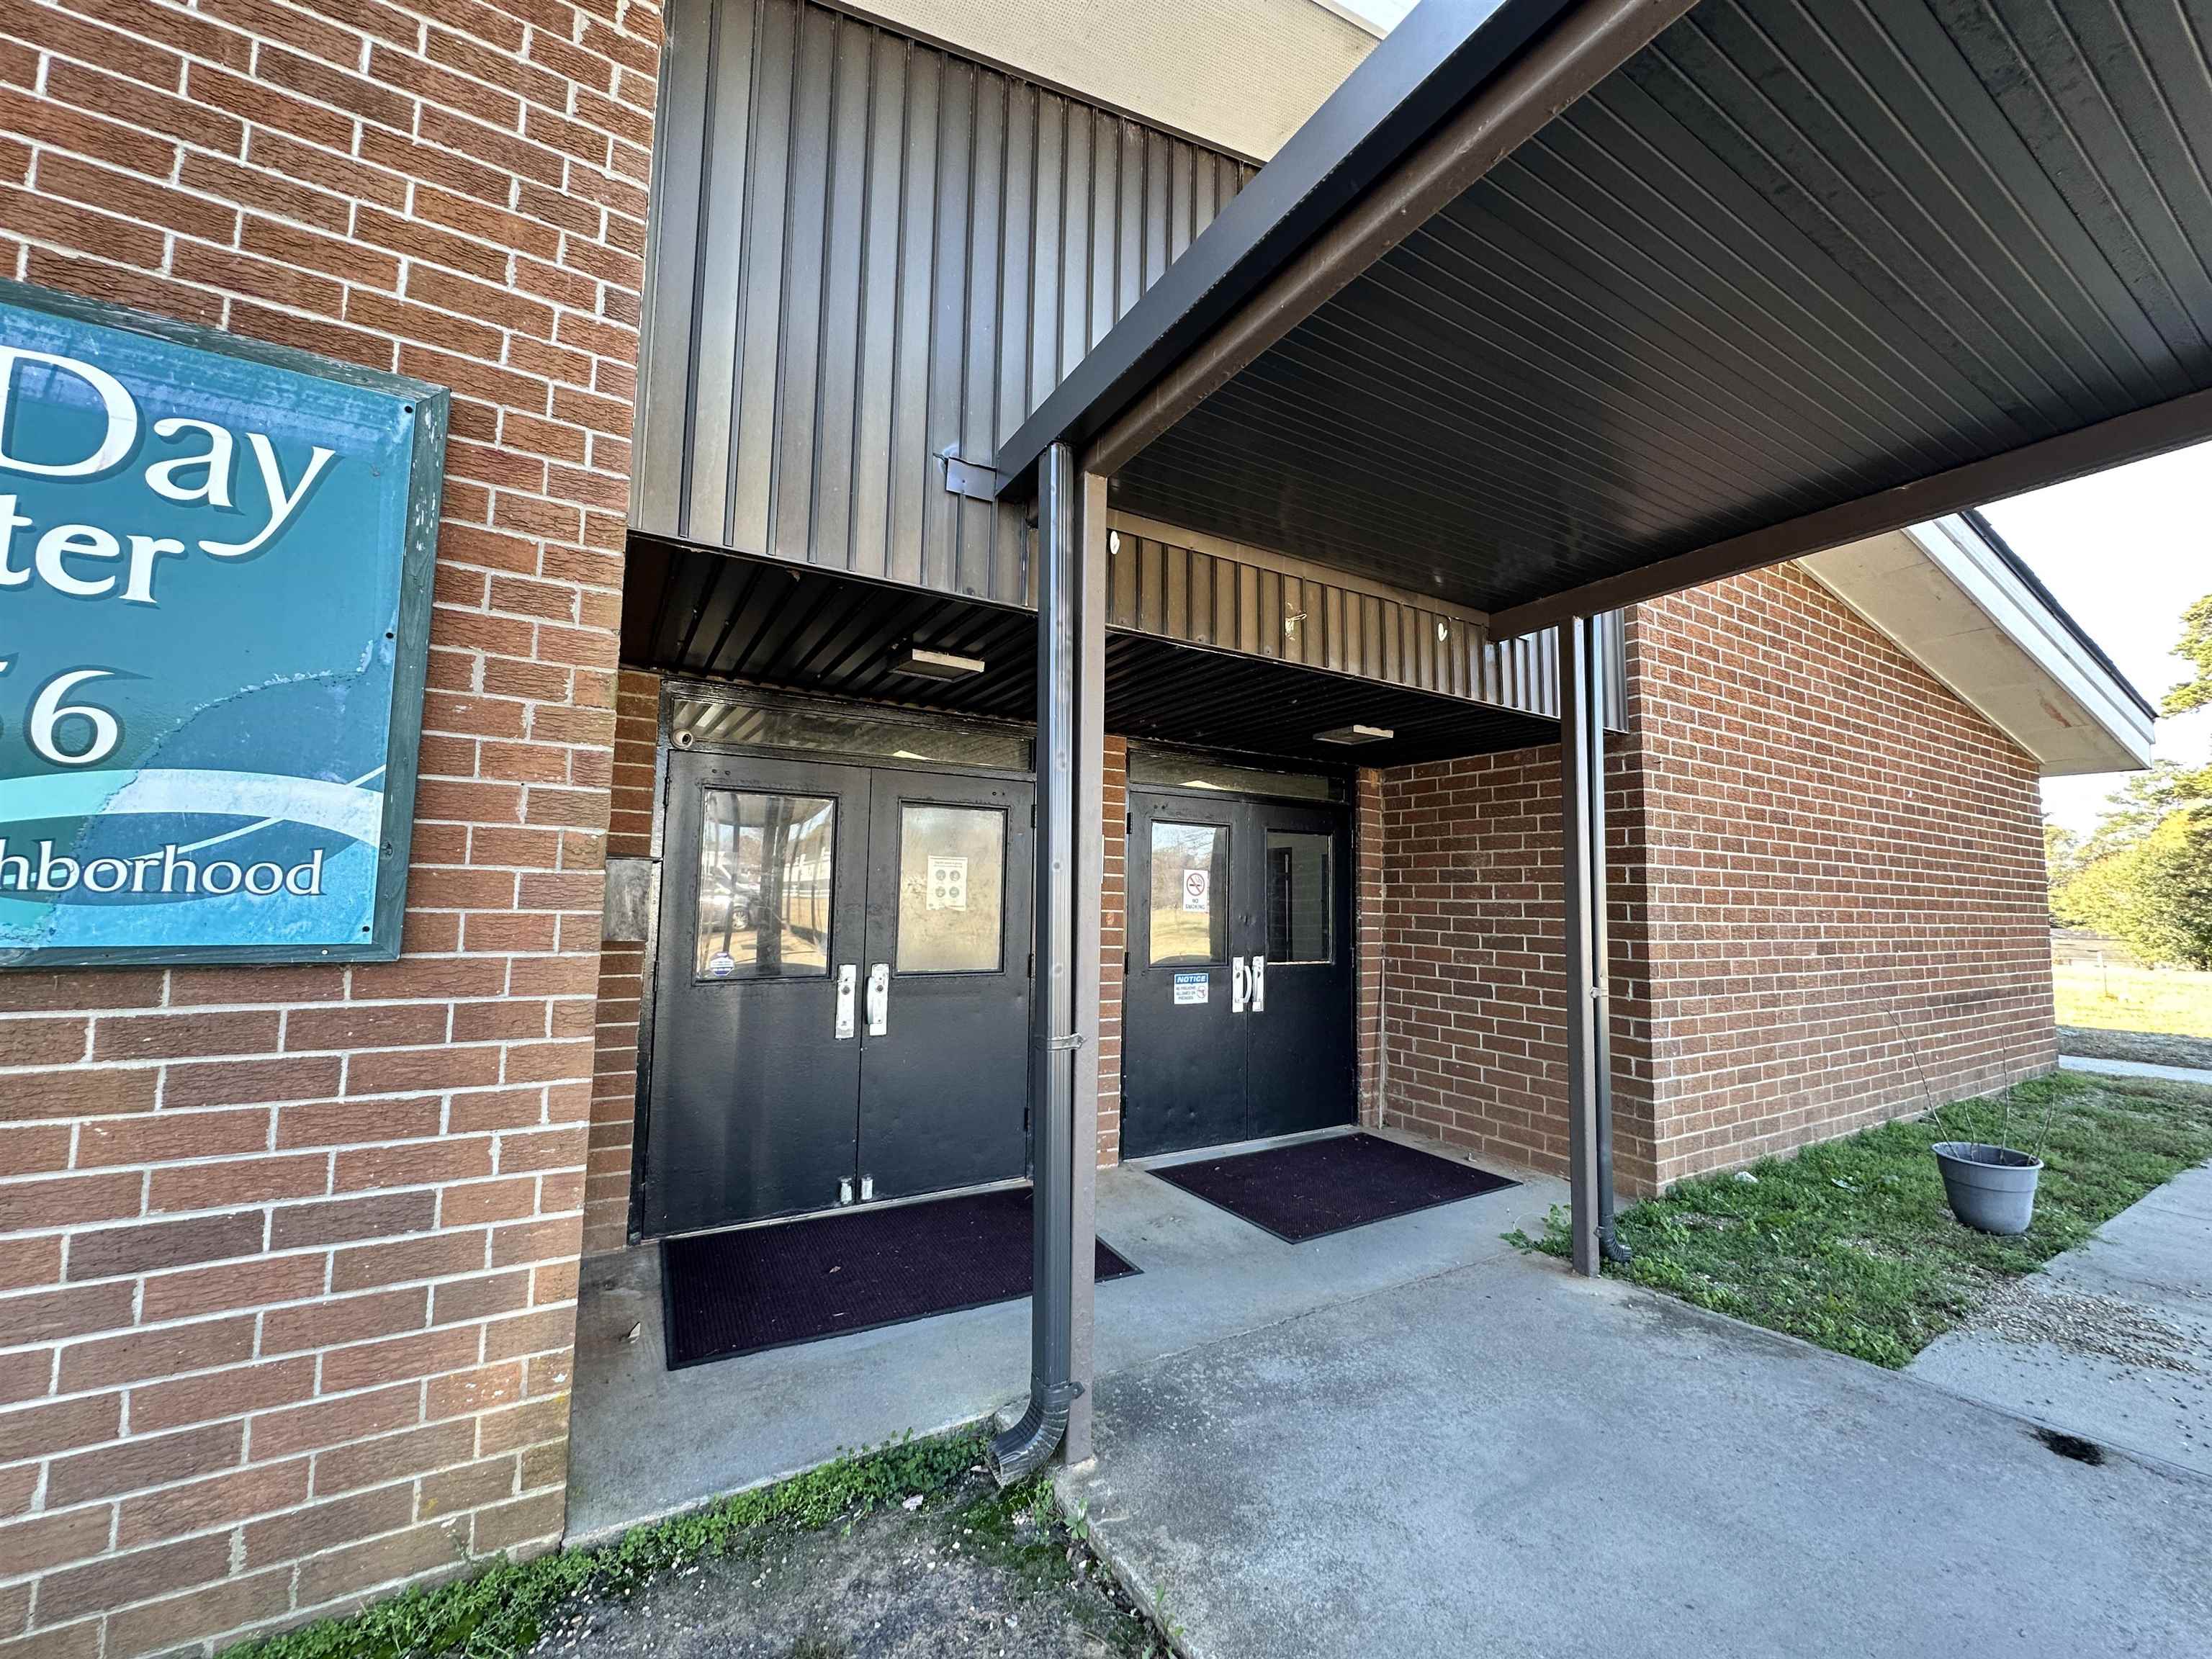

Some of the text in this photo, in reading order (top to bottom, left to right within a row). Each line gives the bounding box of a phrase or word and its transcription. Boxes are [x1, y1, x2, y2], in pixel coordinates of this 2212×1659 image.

[0, 345, 337, 557] Day
[0, 494, 185, 603] ter
[0, 661, 115, 764] 6
[0, 838, 324, 896] hborhood
